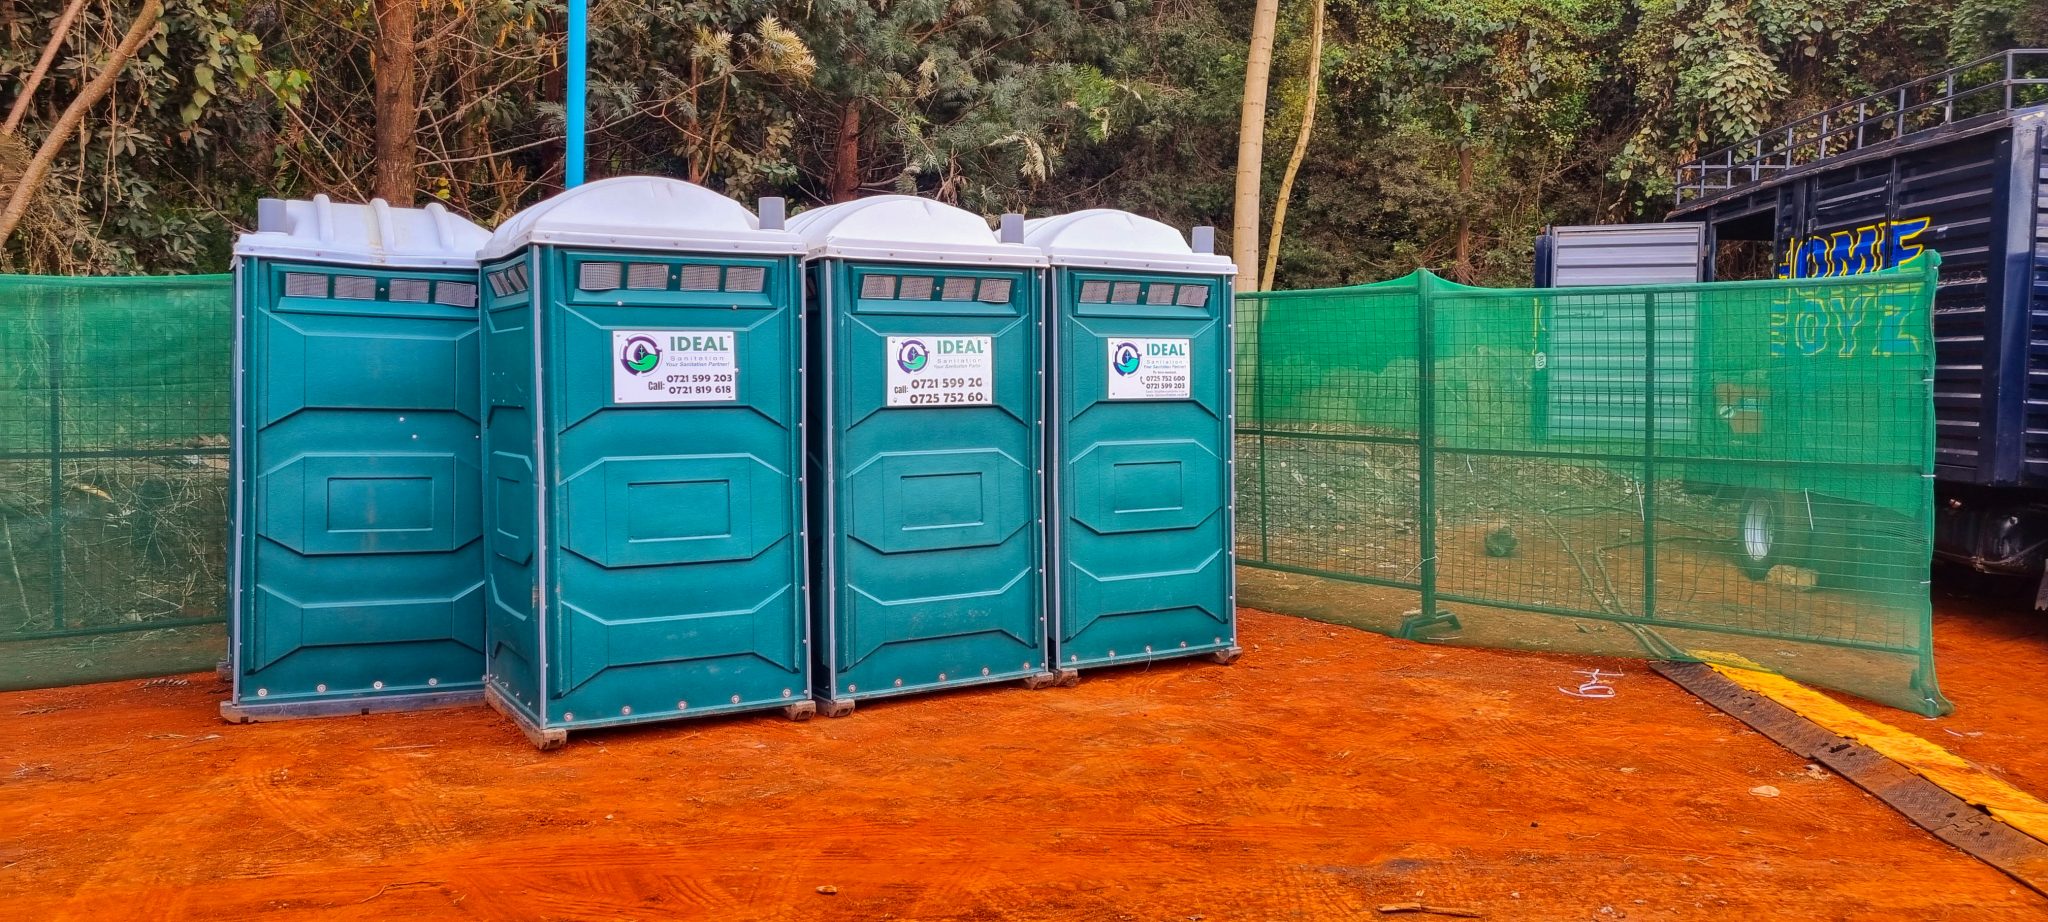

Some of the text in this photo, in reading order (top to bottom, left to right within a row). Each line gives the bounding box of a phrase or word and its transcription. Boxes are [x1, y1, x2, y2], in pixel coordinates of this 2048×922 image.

[670, 336, 729, 352] IDEAL
[937, 339, 984, 354] IDEAL
[1146, 343, 1186, 356] IDEAL
[666, 374, 733, 383] 0721 599 203
[911, 378, 939, 389] 0721
[942, 377, 965, 388] 599
[648, 381, 666, 391] Call:
[669, 385, 732, 395] 0721 819 618
[910, 393, 940, 404] 0725
[943, 392, 964, 403] 752
